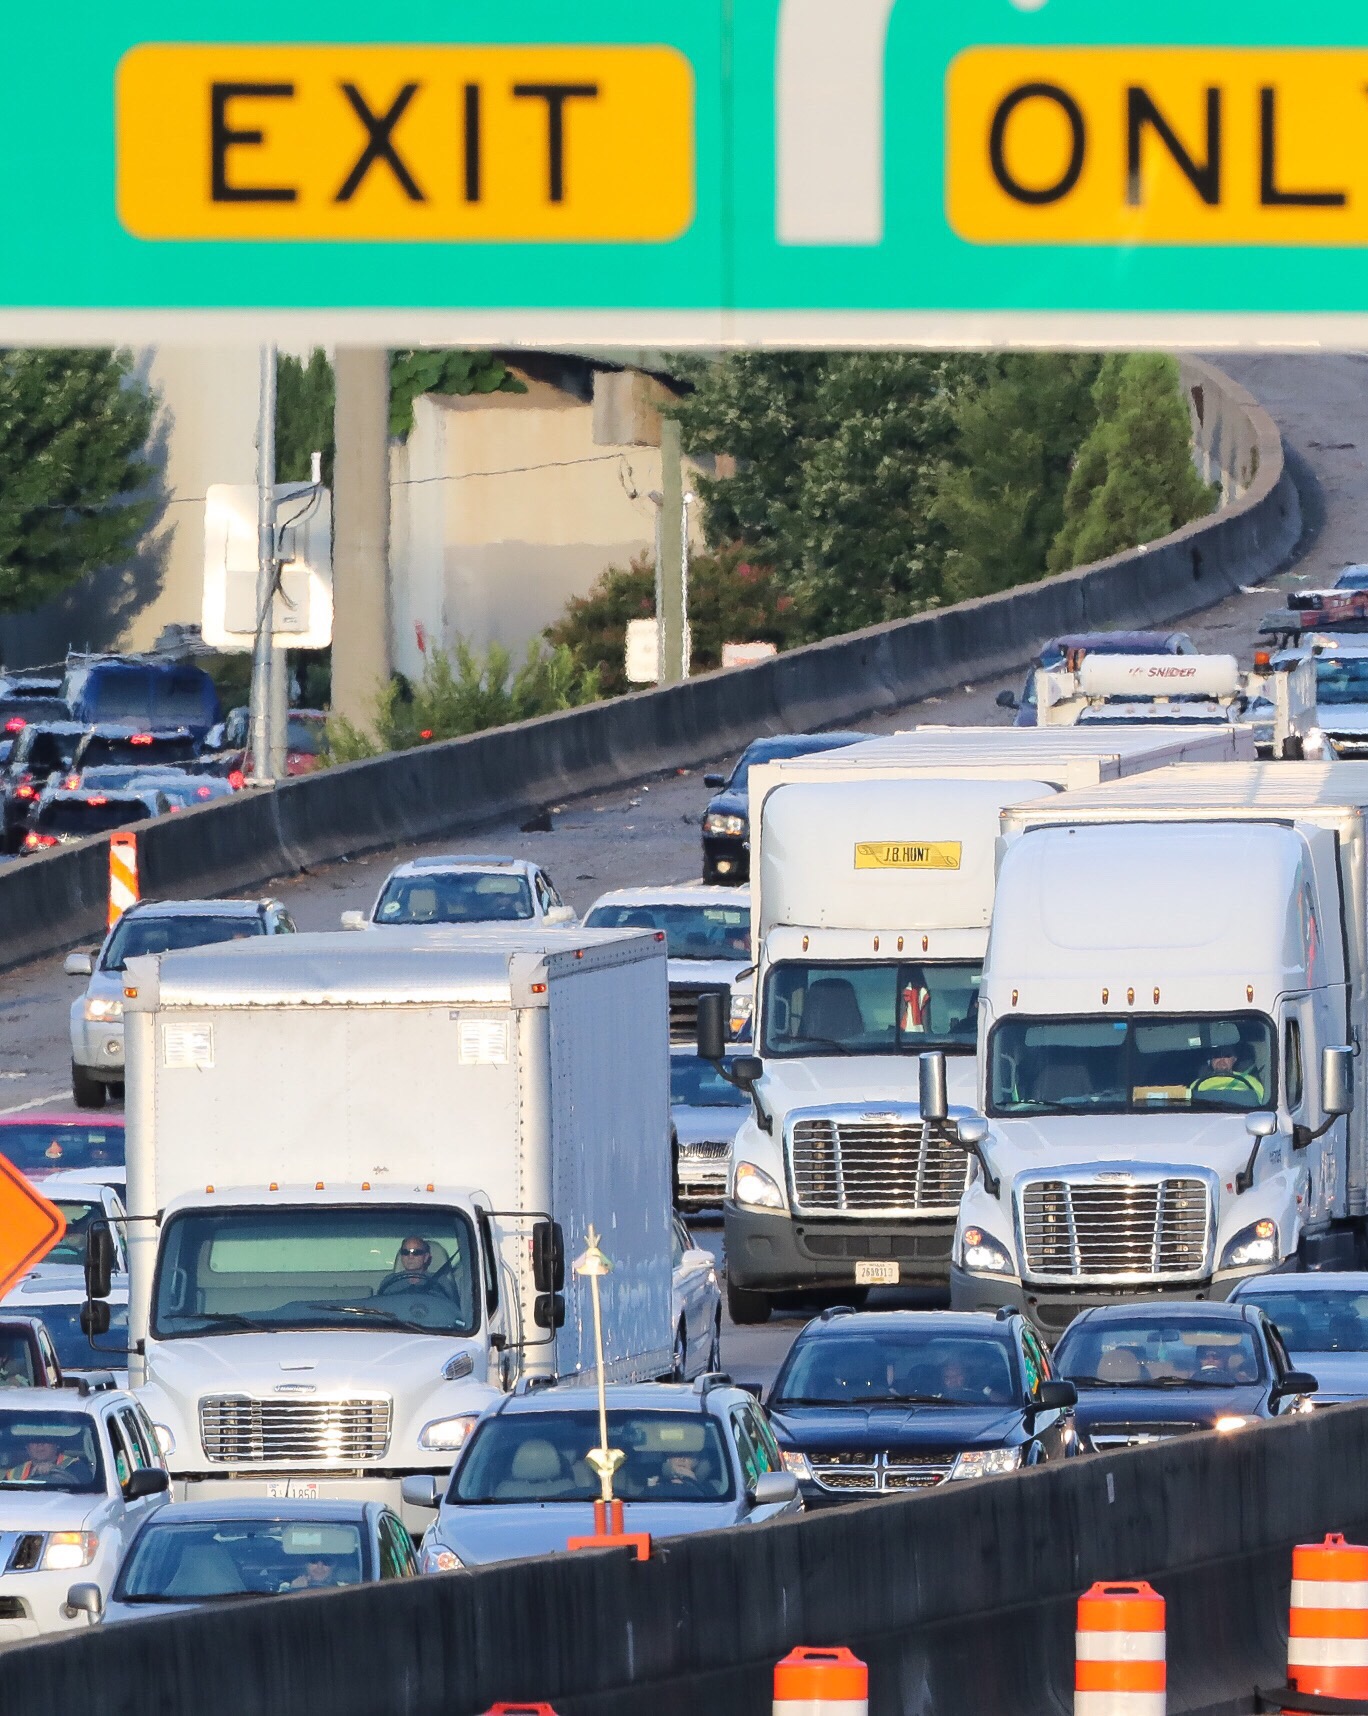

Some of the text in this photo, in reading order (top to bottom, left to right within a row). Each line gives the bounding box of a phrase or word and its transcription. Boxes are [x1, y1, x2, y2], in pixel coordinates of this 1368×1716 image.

[209, 81, 599, 203] EXIT
[1148, 667, 1197, 677] SNIDER
[902, 847, 930, 862] HUNT
